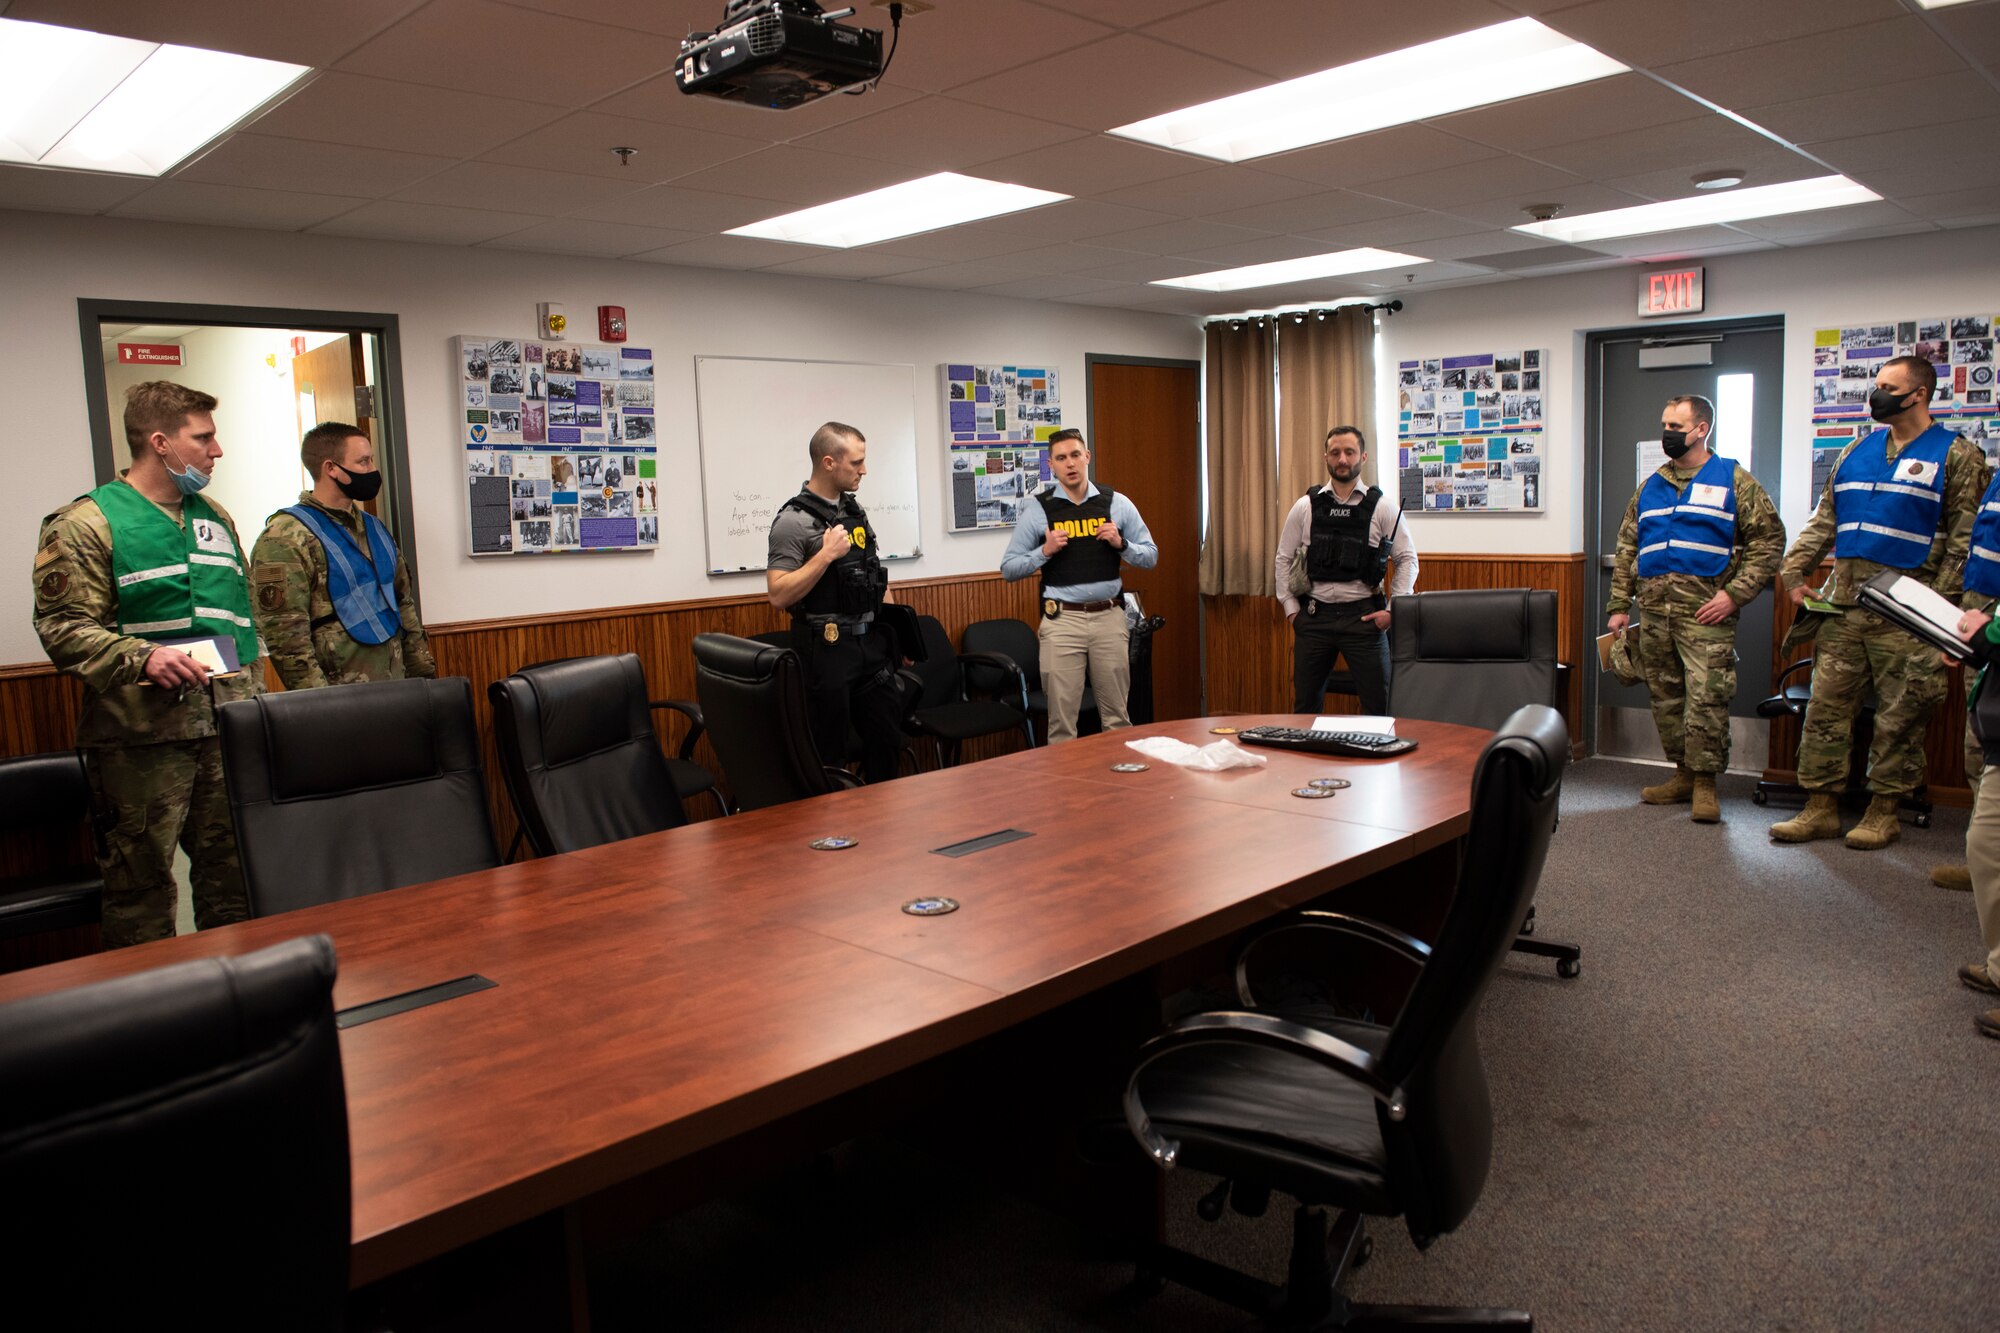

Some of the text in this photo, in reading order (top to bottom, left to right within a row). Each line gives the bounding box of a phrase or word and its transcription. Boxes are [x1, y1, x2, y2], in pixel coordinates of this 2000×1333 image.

[1648, 271, 1696, 312] EXIT
[732, 490, 747, 501] You
[1330, 508, 1351, 517] POLICE
